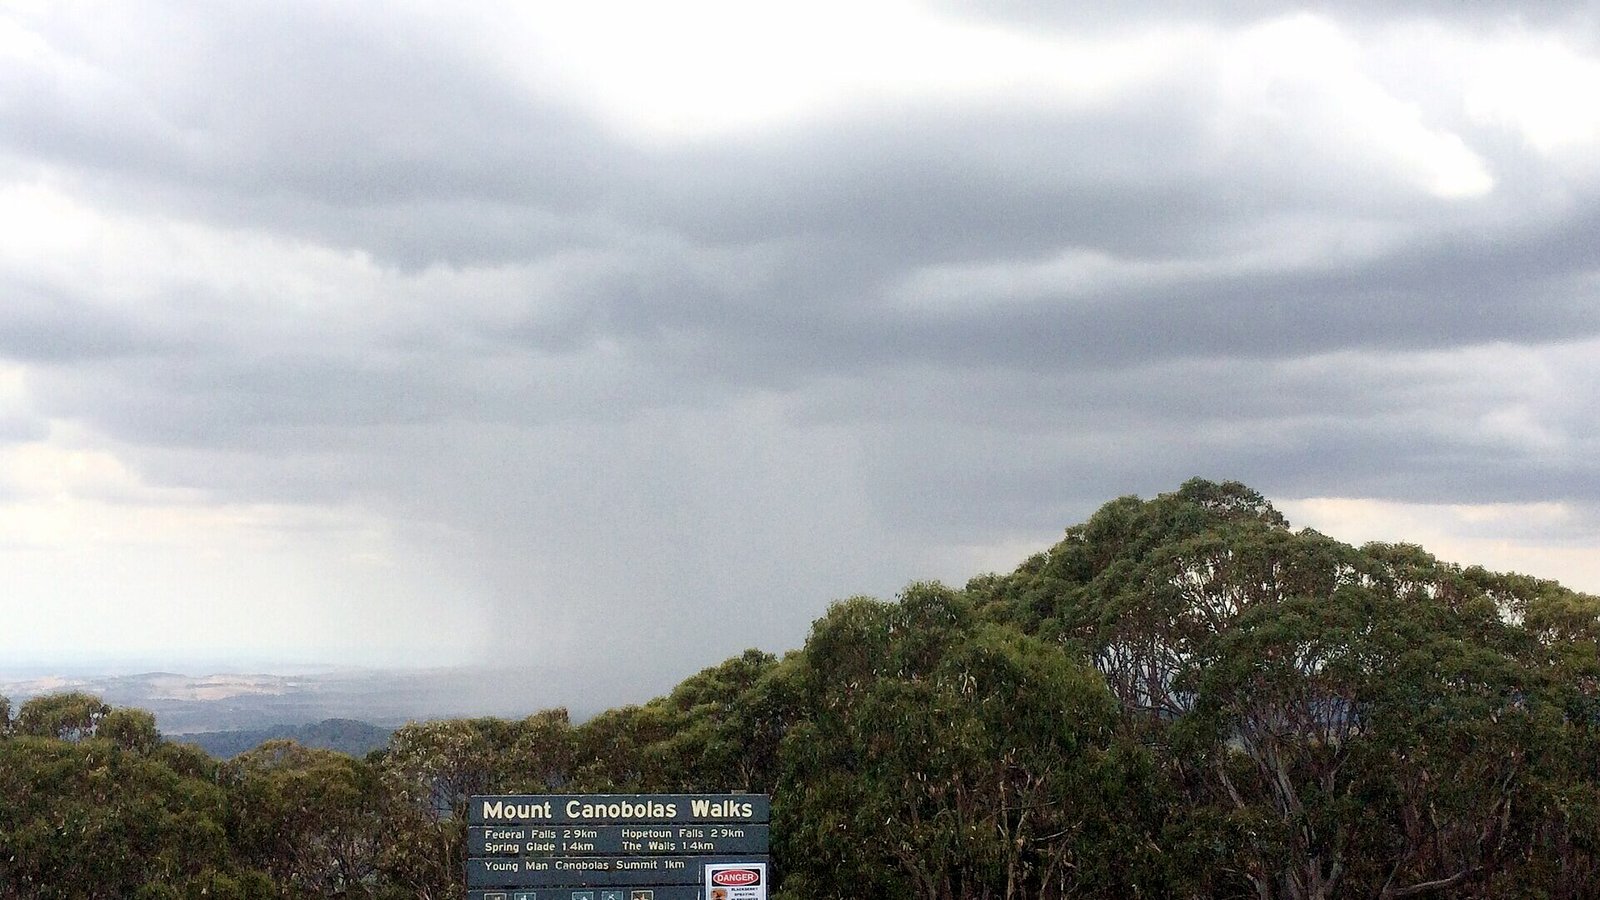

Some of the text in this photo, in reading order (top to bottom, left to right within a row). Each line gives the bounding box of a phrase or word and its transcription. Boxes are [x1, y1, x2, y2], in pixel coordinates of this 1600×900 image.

[483, 799, 753, 819] Mount Canobolas Walks
[484, 829, 598, 839] Federal Falls 29km
[621, 828, 744, 840] Hopetoun Falls 29km
[485, 842, 520, 853] Spring
[526, 842, 556, 851] Glade
[622, 841, 642, 851] The
[648, 841, 676, 851] Walls
[485, 860, 685, 873] Young Man Canobolas Summit 1km
[717, 873, 754, 882] DANGER
